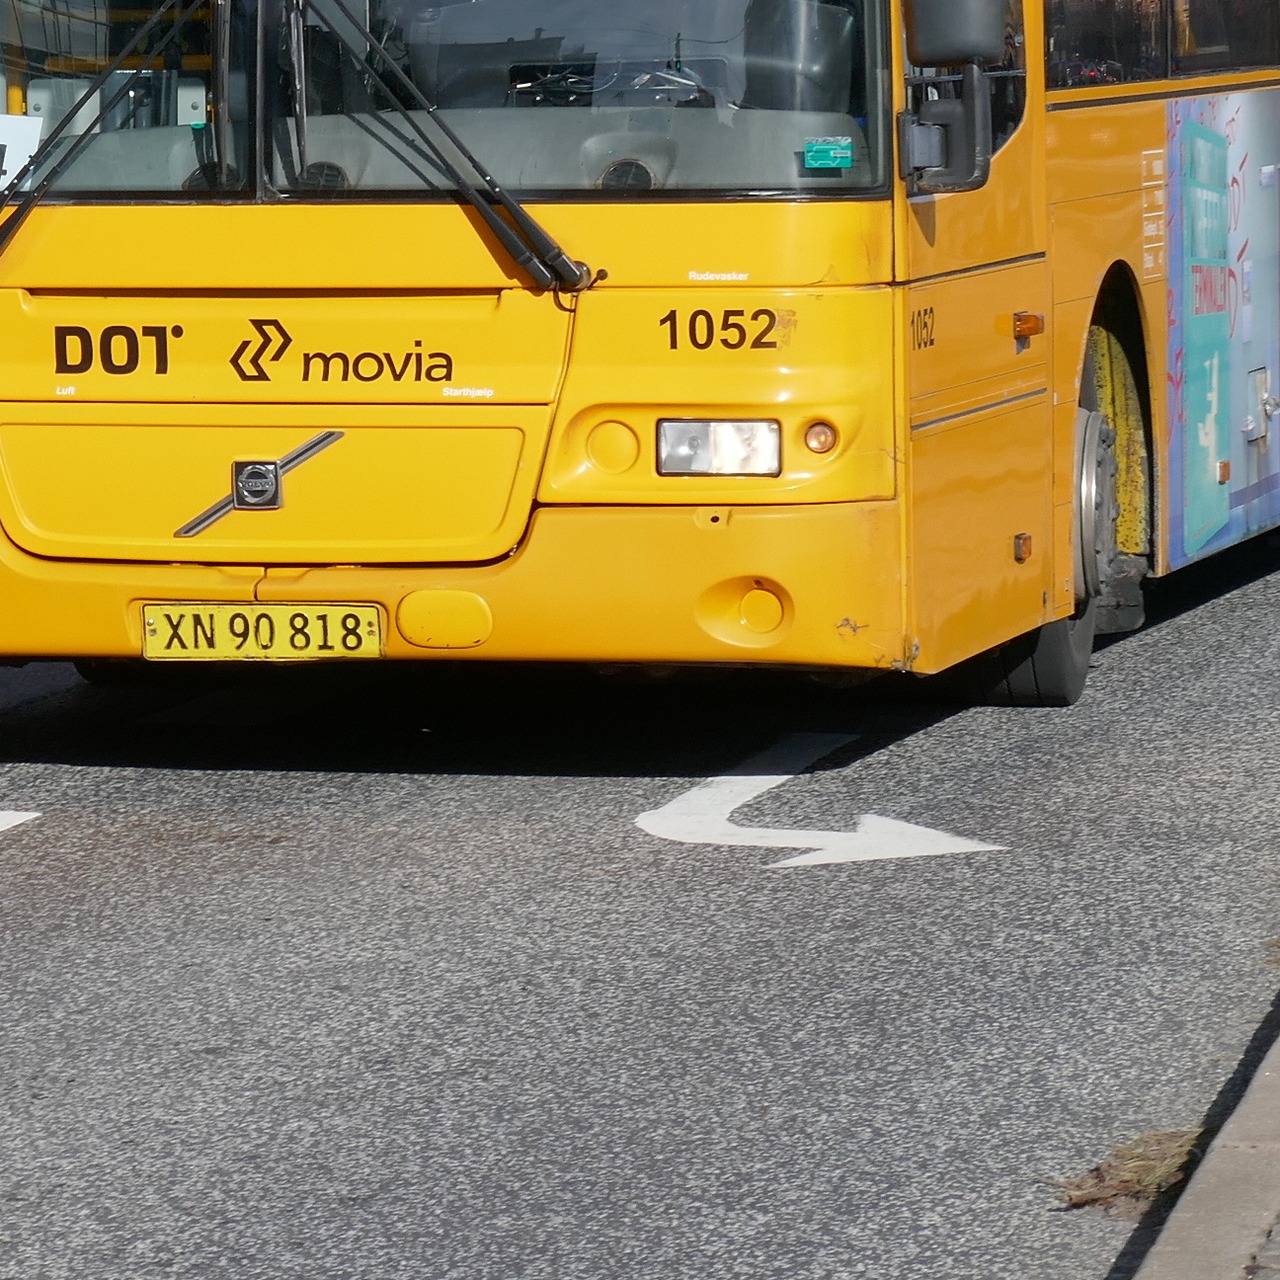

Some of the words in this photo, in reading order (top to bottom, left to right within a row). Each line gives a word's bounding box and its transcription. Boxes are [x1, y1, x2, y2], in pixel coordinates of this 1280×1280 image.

[688, 271, 749, 281] Rudevasker
[54, 324, 184, 375] DOT
[658, 308, 778, 351] 1052
[910, 306, 936, 352] 1052
[302, 339, 454, 383] movia
[56, 385, 76, 396] Luft
[442, 386, 494, 400] Starthjælp
[163, 613, 216, 651] XN
[229, 612, 276, 651] 90
[289, 612, 364, 652] 818
